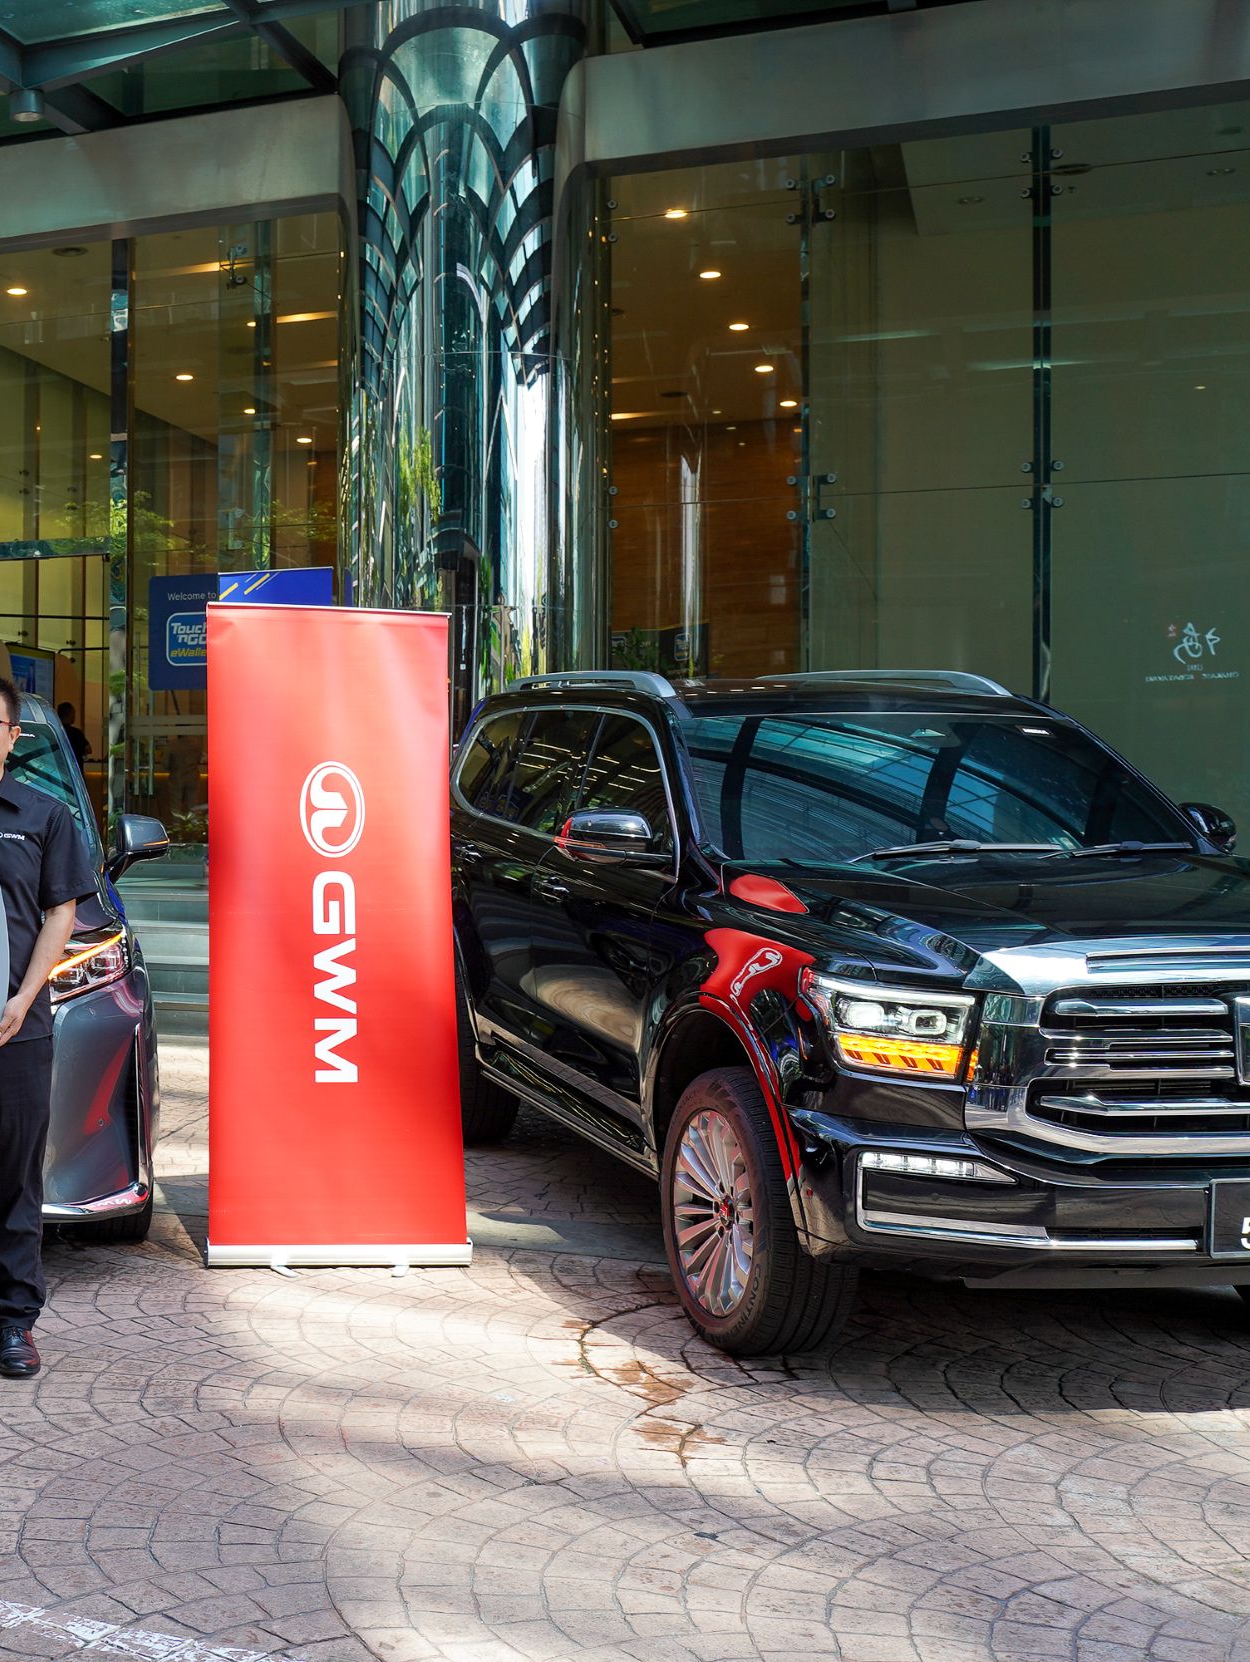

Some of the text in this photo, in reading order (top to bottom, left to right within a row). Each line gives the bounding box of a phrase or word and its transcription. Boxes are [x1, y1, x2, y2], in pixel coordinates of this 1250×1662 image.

[167, 592, 206, 601] Welcome
[170, 647, 207, 657] eWalle
[3, 833, 25, 841] GWM
[311, 870, 359, 1083] GWM
